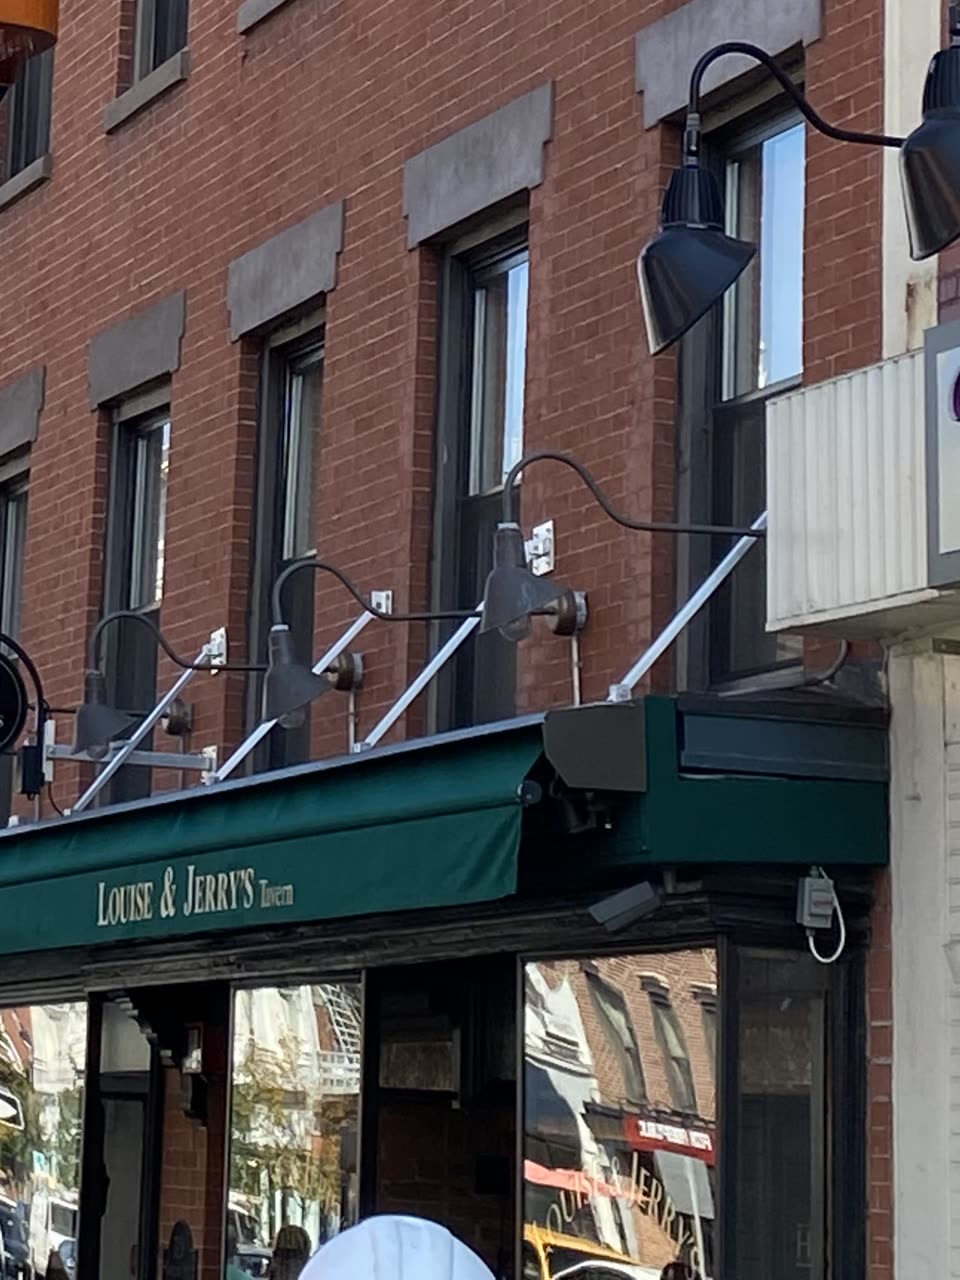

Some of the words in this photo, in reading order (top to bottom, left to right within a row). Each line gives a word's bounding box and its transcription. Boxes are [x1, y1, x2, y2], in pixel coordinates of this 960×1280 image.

[96, 881, 154, 927] LOUISE
[160, 866, 177, 919] &
[183, 865, 256, 917] JERRY'S
